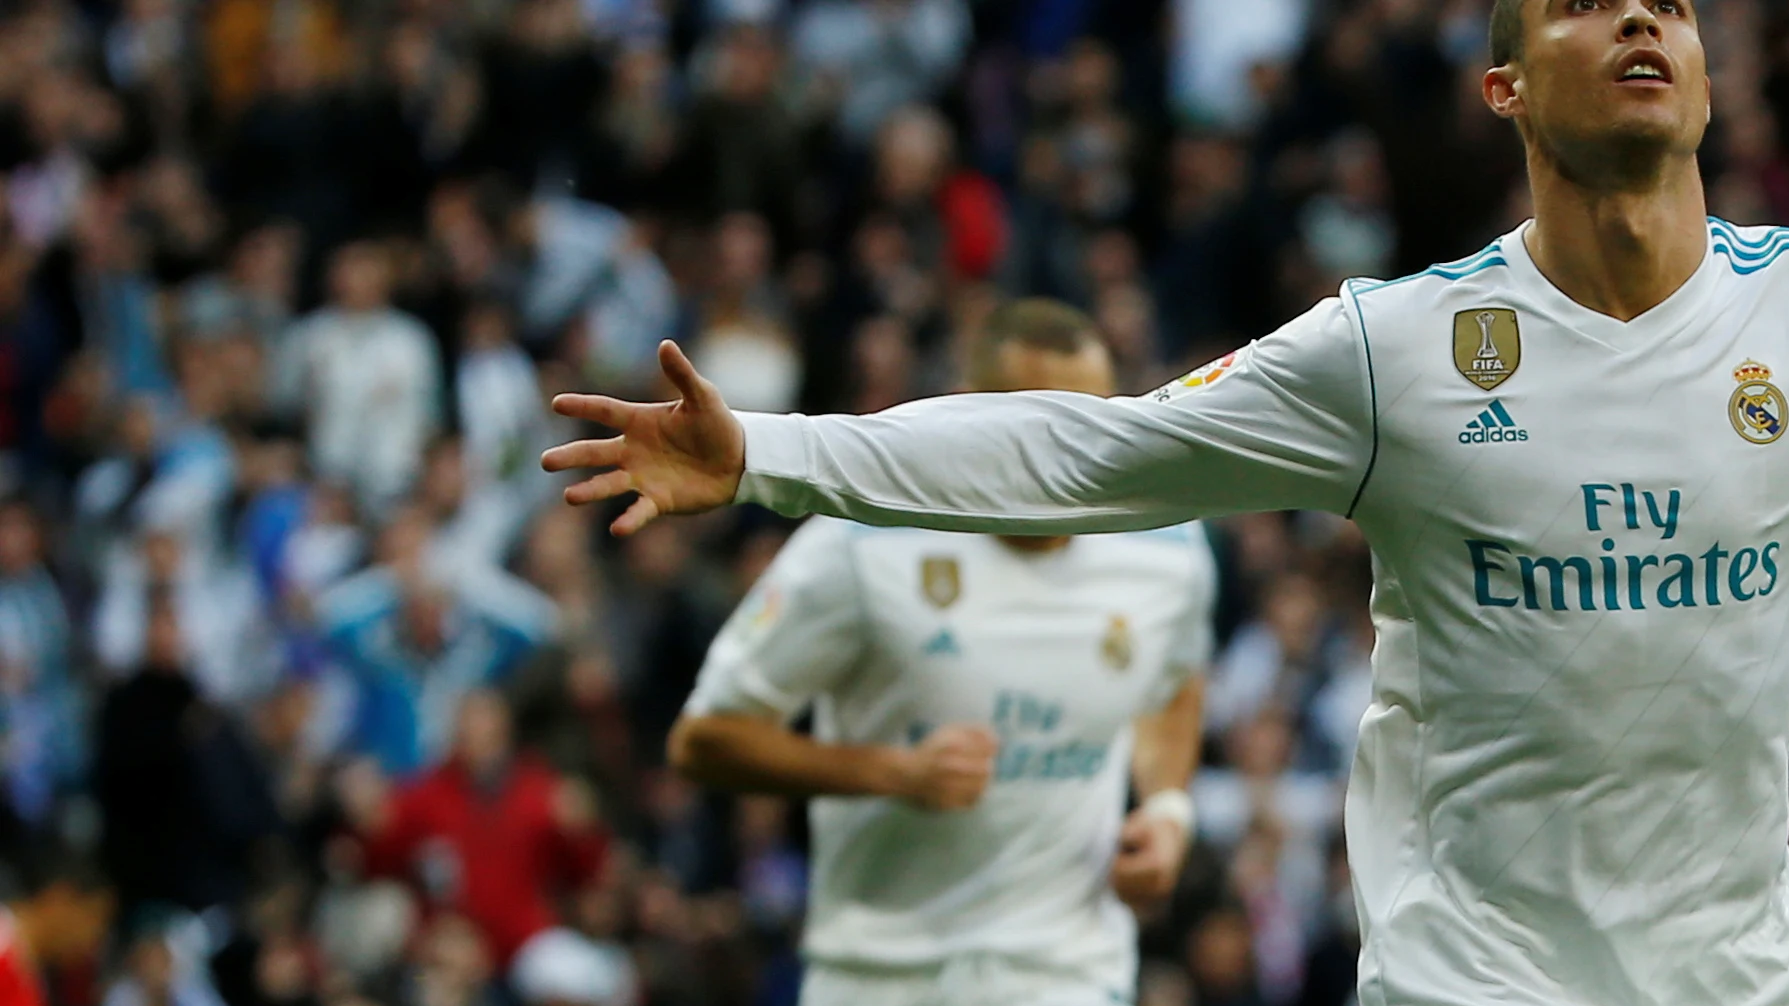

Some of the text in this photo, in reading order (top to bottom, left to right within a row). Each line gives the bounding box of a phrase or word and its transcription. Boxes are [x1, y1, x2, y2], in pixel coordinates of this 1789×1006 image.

[1473, 359, 1504, 370] FIFA
[1458, 427, 1529, 444] adidas
[1581, 482, 1681, 540] Fly
[1464, 537, 1780, 611] Emirates
